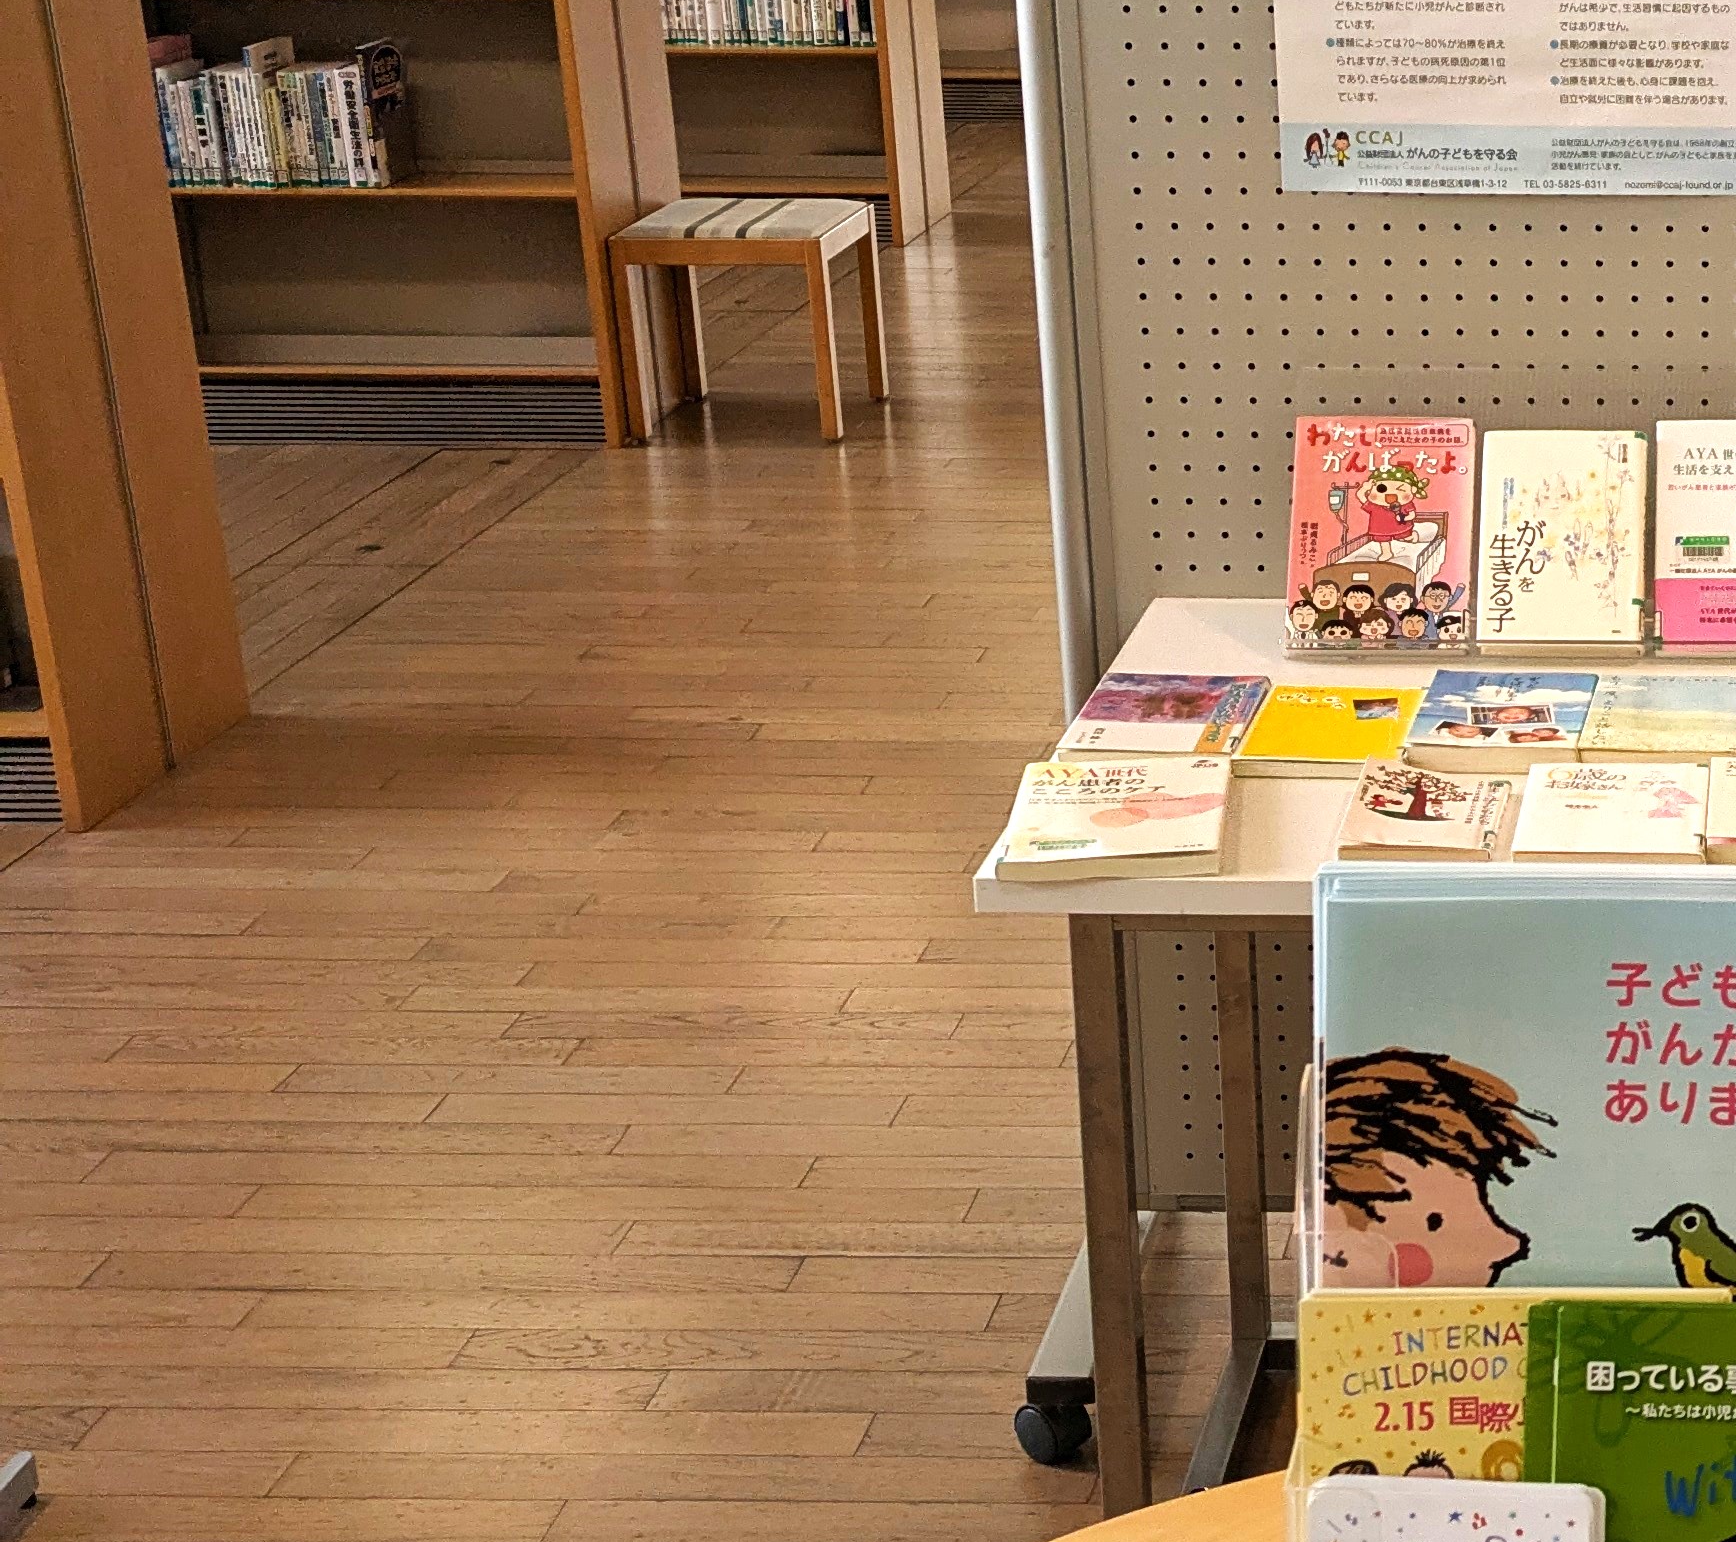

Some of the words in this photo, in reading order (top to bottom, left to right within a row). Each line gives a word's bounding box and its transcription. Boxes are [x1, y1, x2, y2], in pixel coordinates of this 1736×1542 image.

[1355, 130, 1403, 146] CCAJ
[1406, 147, 1518, 160] がんの子どもを守る会
[1524, 180, 1540, 188] TEL
[1322, 448, 1467, 474] がんばったよ。
[1516, 520, 1546, 592] がんを
[1487, 534, 1517, 633] 生きる子
[1032, 786, 1165, 795] こころのケア
[1343, 1355, 1507, 1396] CHILDHOOD
[1374, 1401, 1435, 1432] 2.15
